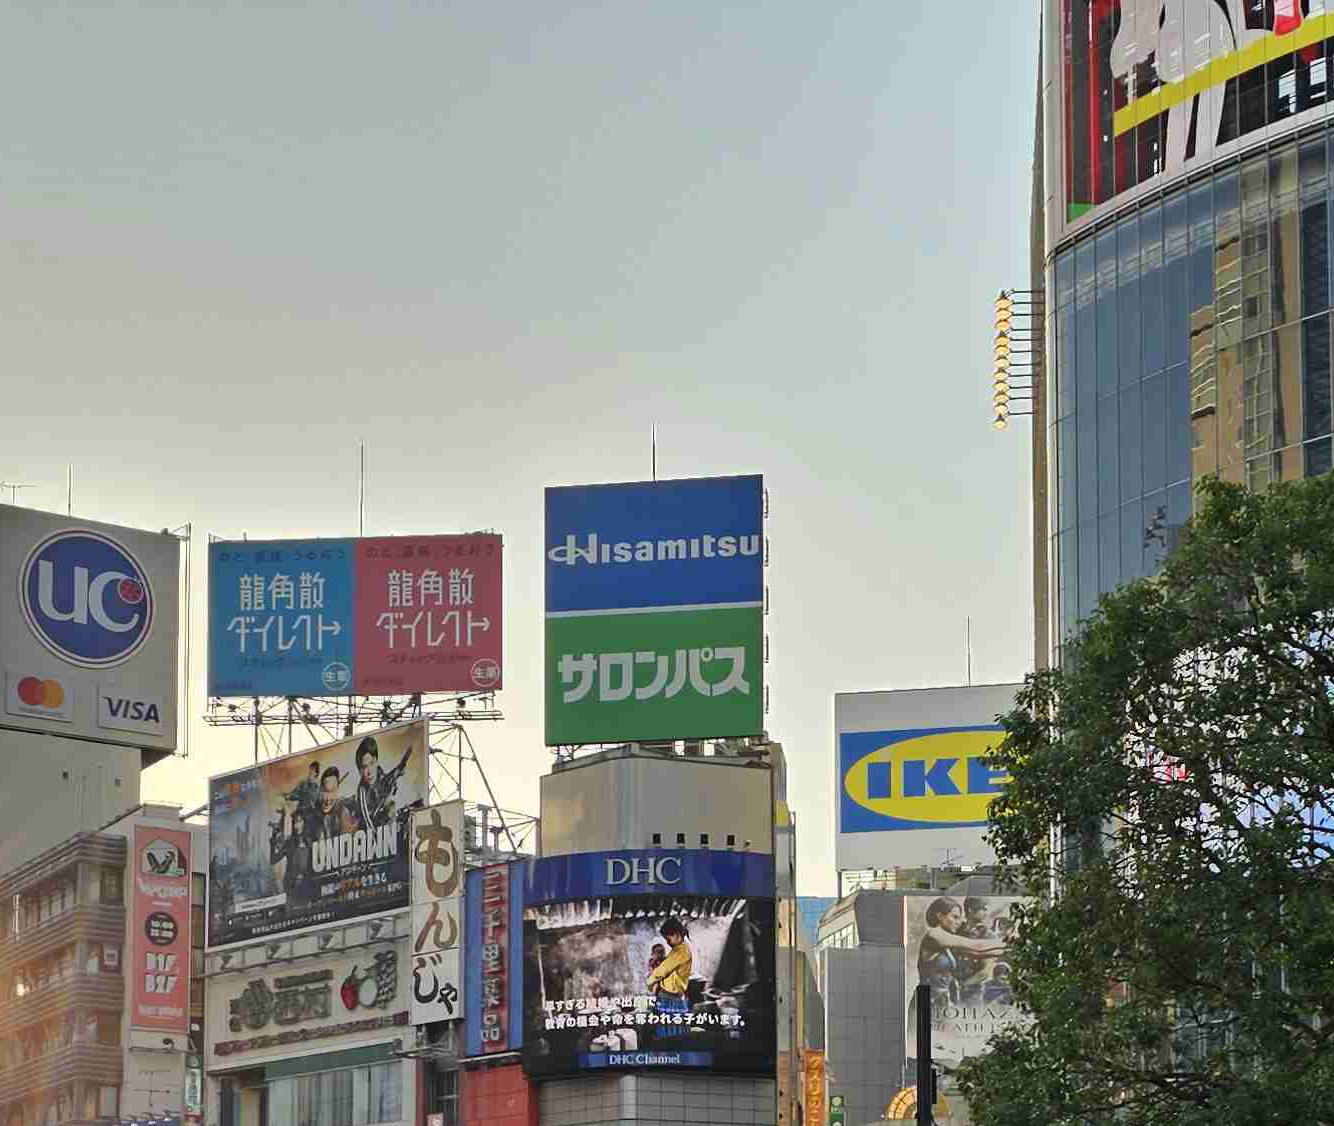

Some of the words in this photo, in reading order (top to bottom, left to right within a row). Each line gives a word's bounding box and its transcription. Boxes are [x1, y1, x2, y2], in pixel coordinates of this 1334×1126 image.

[548, 532, 760, 565] Hisamitsu
[238, 571, 326, 611] 龍角散
[387, 568, 475, 608] 龍角散
[558, 646, 750, 704] サロンパス
[104, 697, 161, 724] VISA
[867, 756, 1015, 800] IKE
[312, 822, 397, 873] UNDAWN
[603, 856, 683, 886] DHC
[413, 808, 459, 1015] もんじゃ
[609, 1053, 634, 1065] DHC
[635, 1053, 681, 1065] Channel
